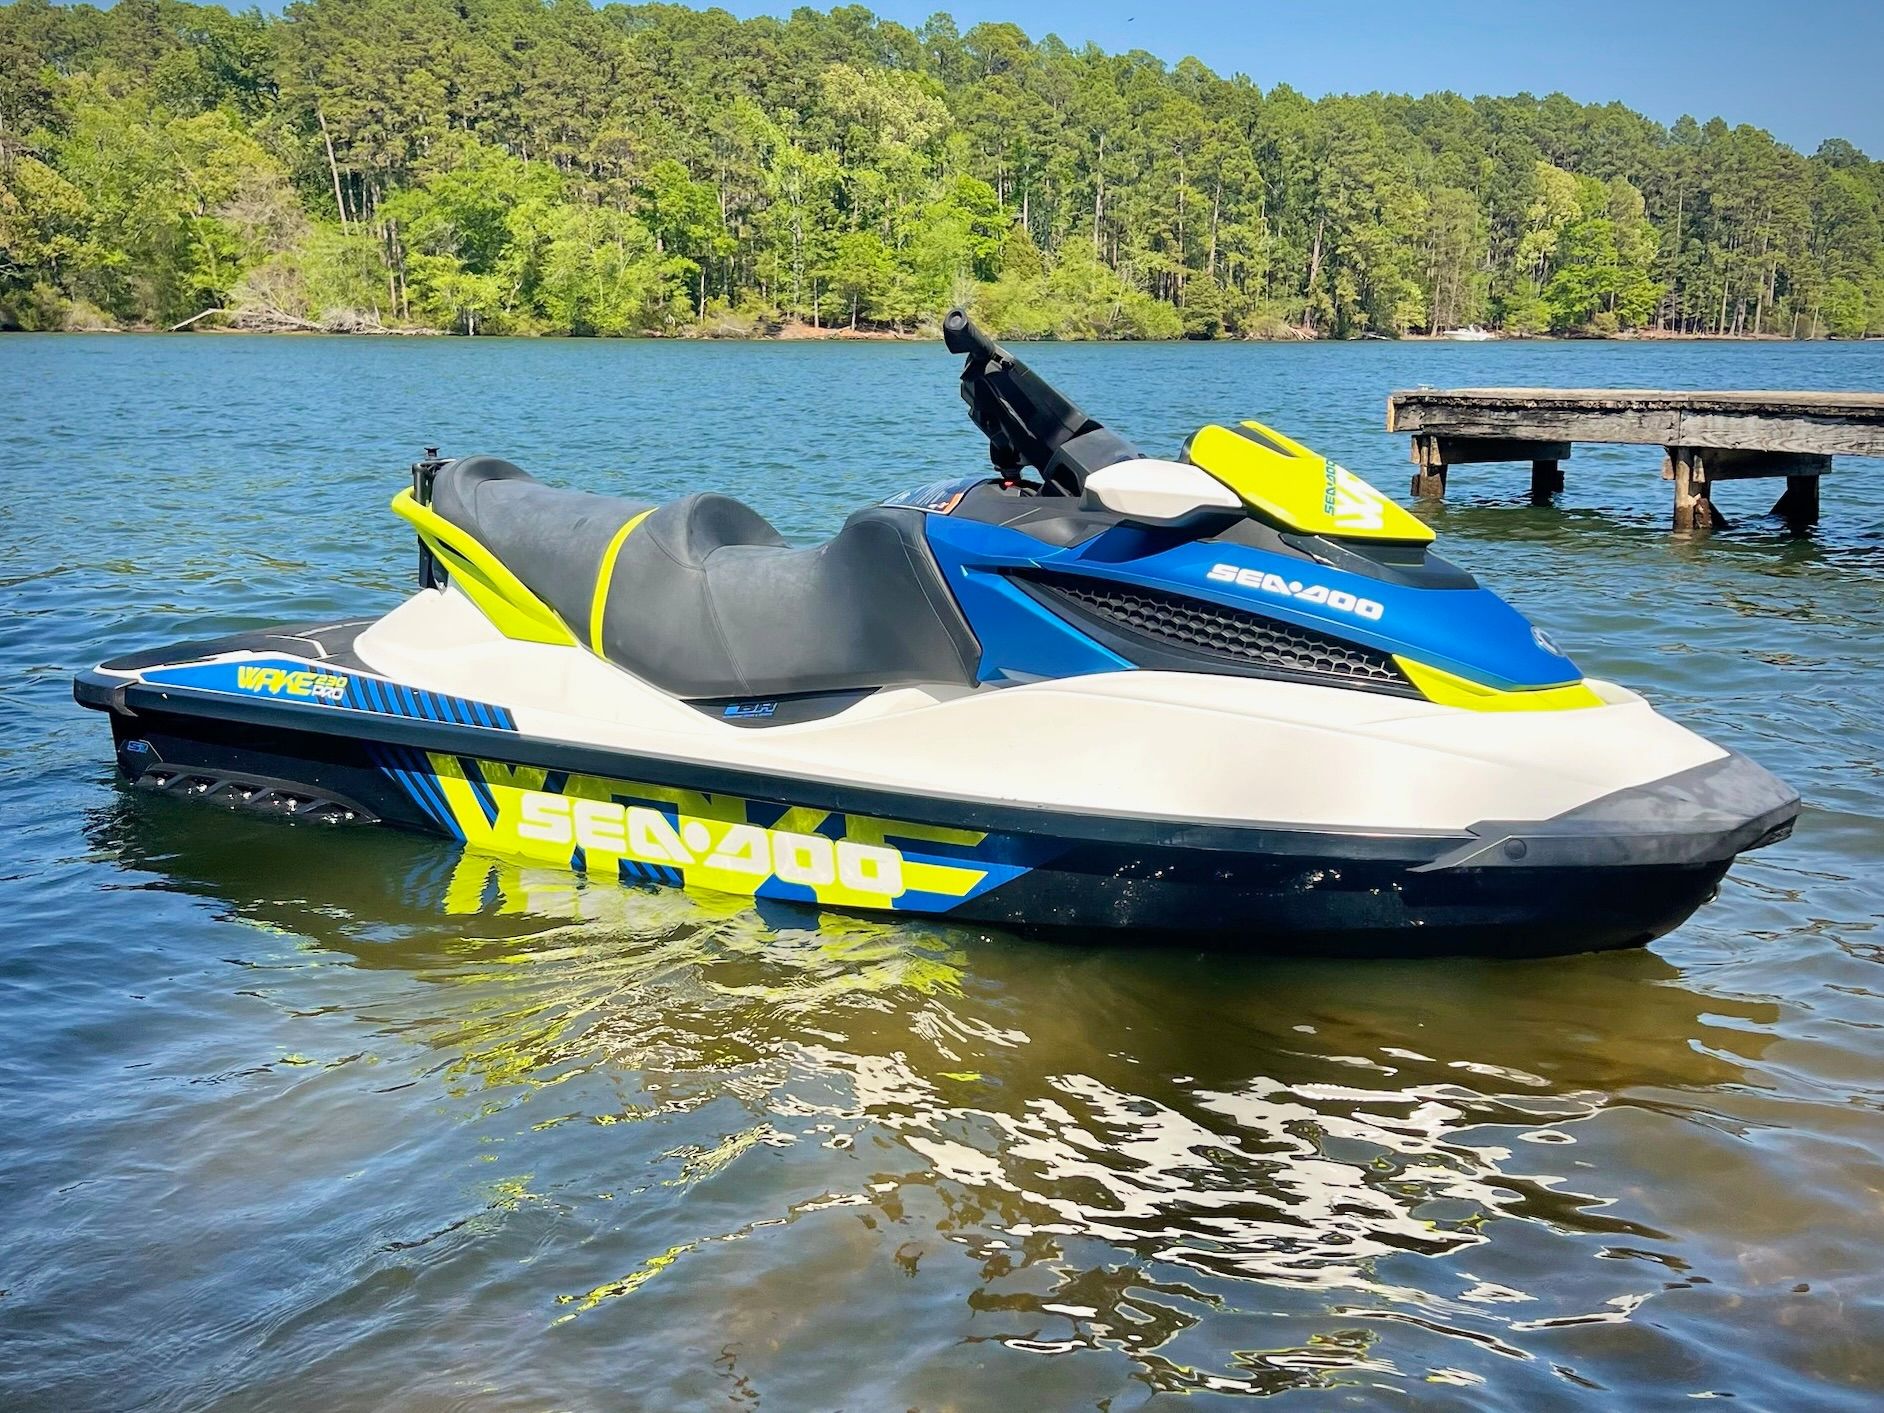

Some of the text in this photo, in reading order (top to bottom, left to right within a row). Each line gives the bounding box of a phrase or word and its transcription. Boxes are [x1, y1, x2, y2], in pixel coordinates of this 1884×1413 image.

[237, 666, 349, 696] WAKE 230
[311, 685, 345, 701] PRO
